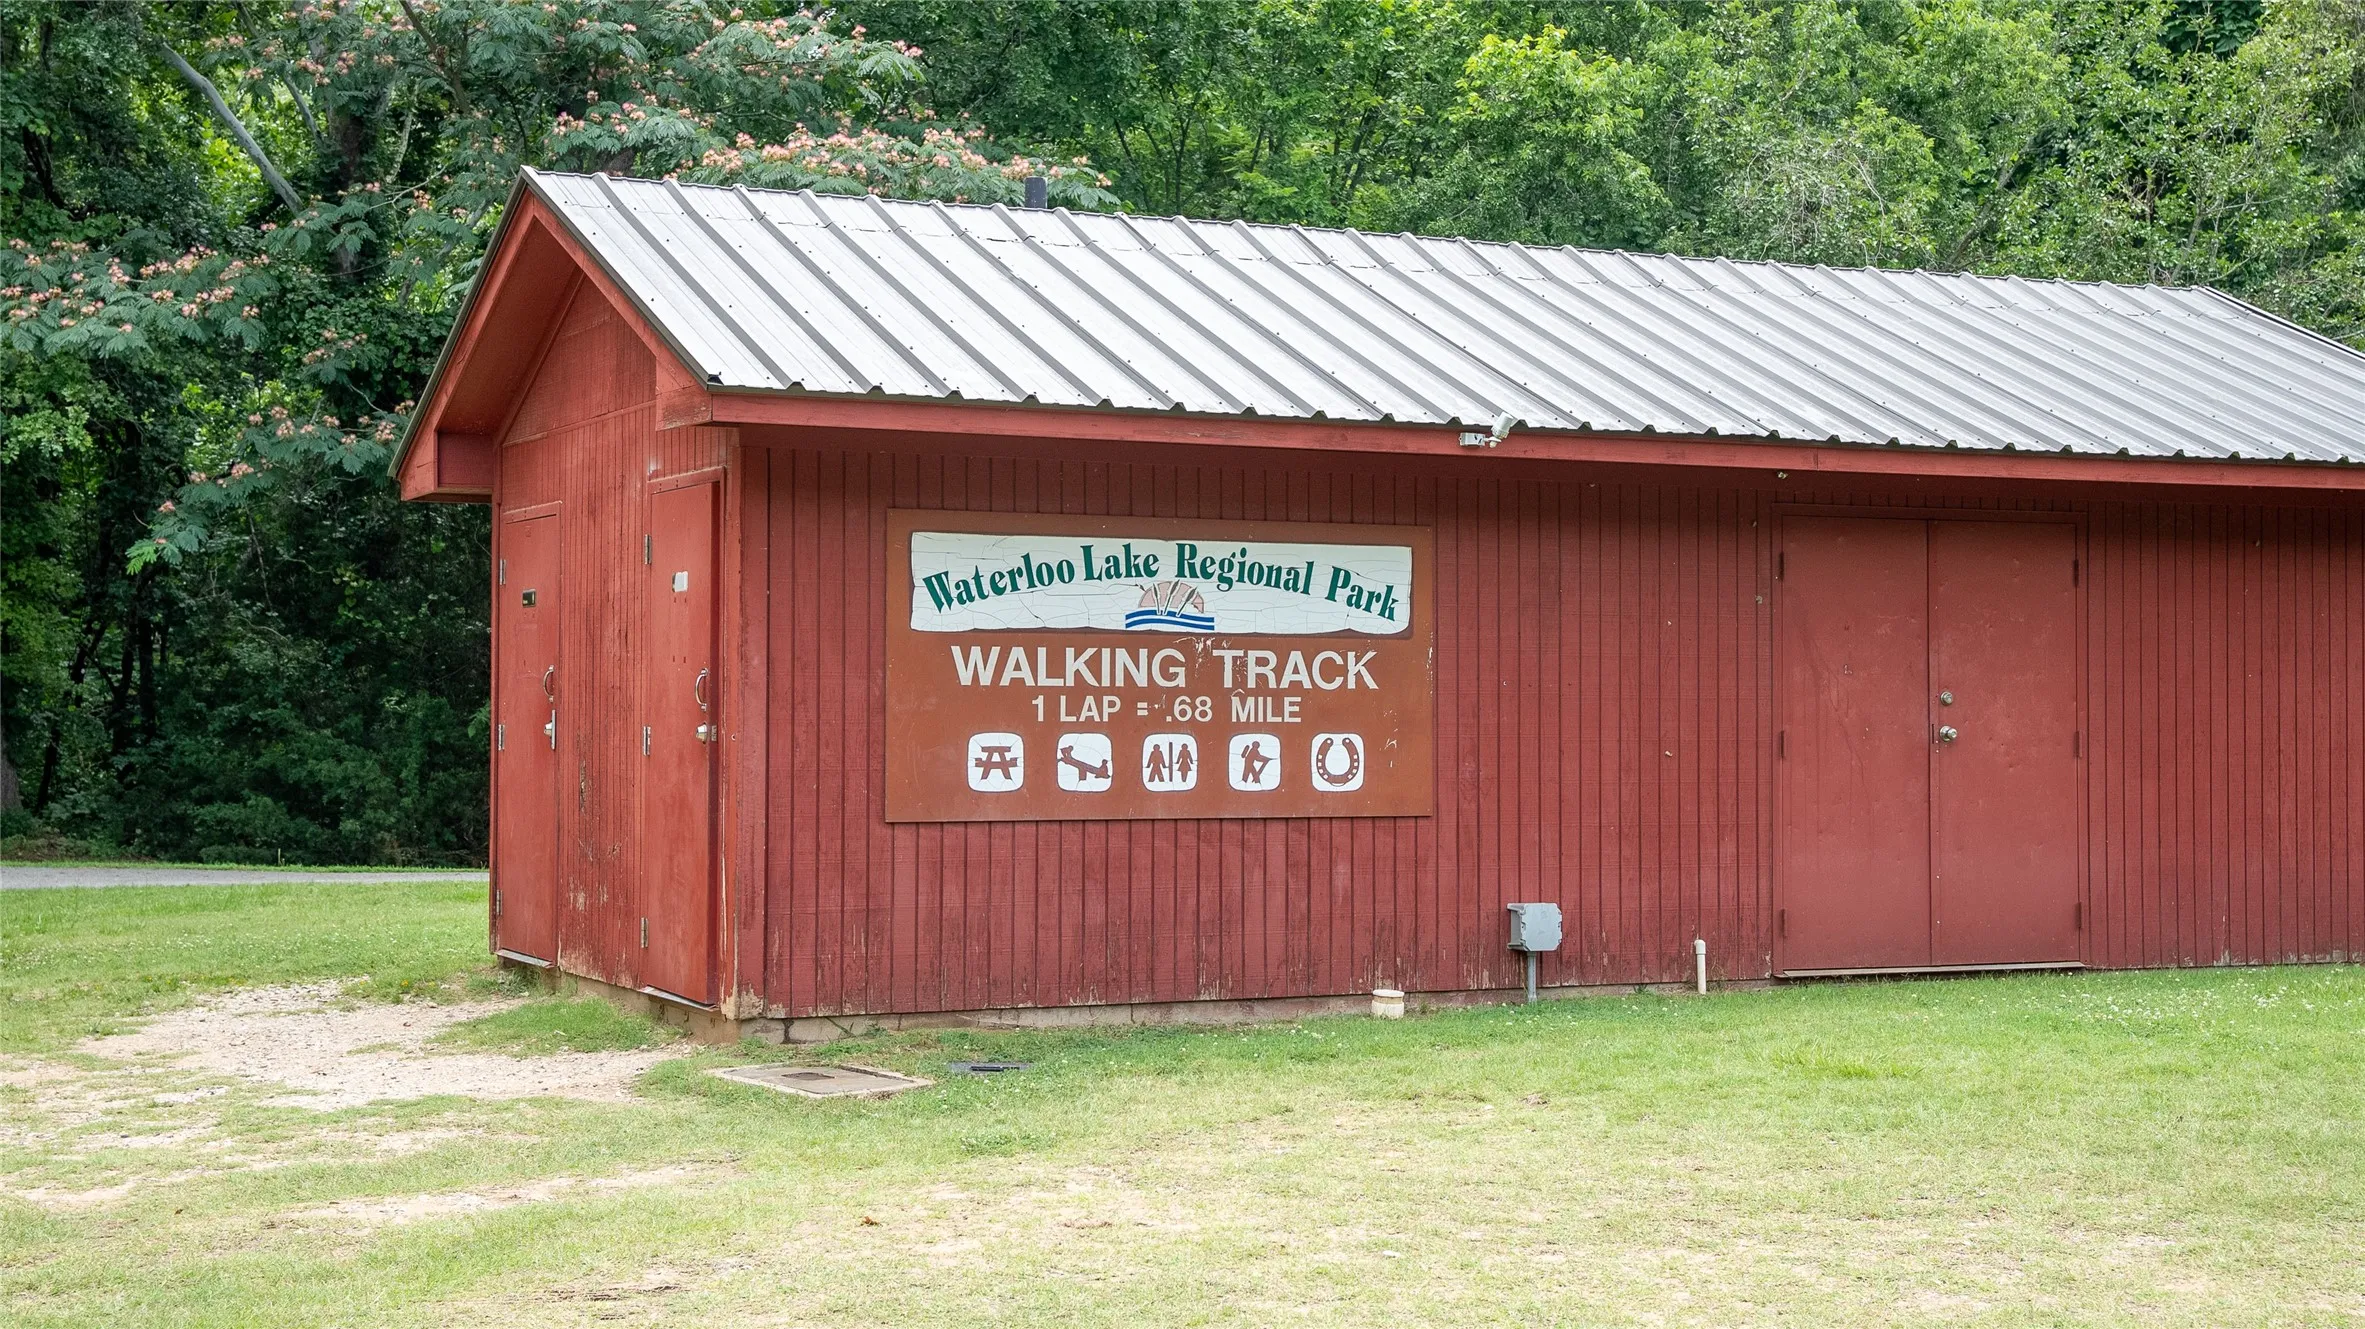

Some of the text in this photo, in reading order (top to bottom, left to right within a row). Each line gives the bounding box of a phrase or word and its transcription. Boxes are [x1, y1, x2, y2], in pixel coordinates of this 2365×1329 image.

[922, 542, 1399, 622] Waterloo Lake Regional Park
[951, 646, 1380, 690] WALKING TRACK
[1031, 695, 1302, 723] 1 LAP = .68 MILE
